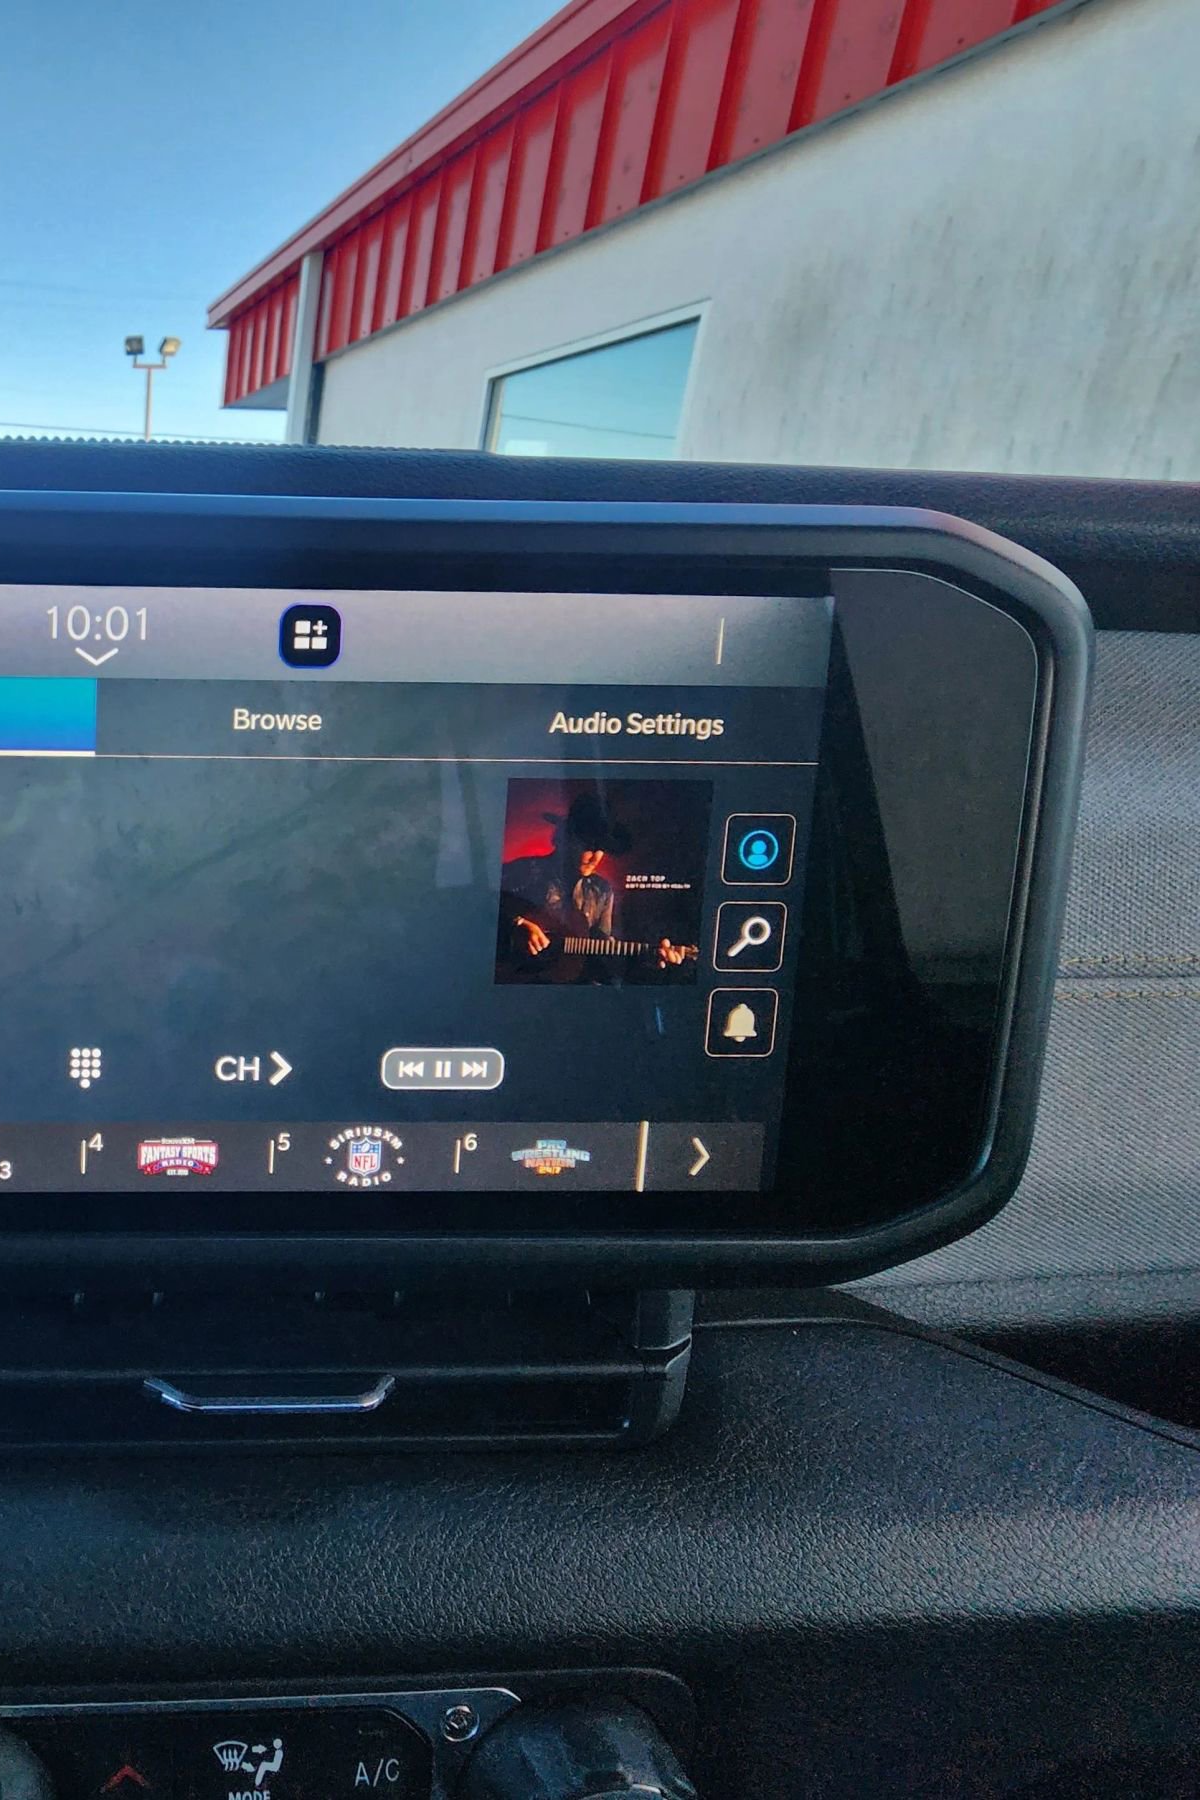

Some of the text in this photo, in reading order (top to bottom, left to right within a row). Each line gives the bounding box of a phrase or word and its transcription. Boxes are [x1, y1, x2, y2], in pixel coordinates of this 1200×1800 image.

[46, 606, 149, 641] 10:01
[233, 708, 322, 731] Browse
[549, 712, 725, 740] Audio Settings
[215, 1057, 260, 1081] CH
[88, 1132, 104, 1151] 4
[277, 1133, 291, 1151] 5
[329, 1126, 404, 1151] SIRIUSXM
[463, 1133, 478, 1151] 6
[141, 1147, 216, 1165] FANTASY SPORTS
[161, 1159, 194, 1167] RADIO
[353, 1155, 377, 1169] NFL
[511, 1149, 591, 1162] WRESTLING
[336, 1170, 392, 1187] RADIO
[354, 1758, 400, 1788] A/C
